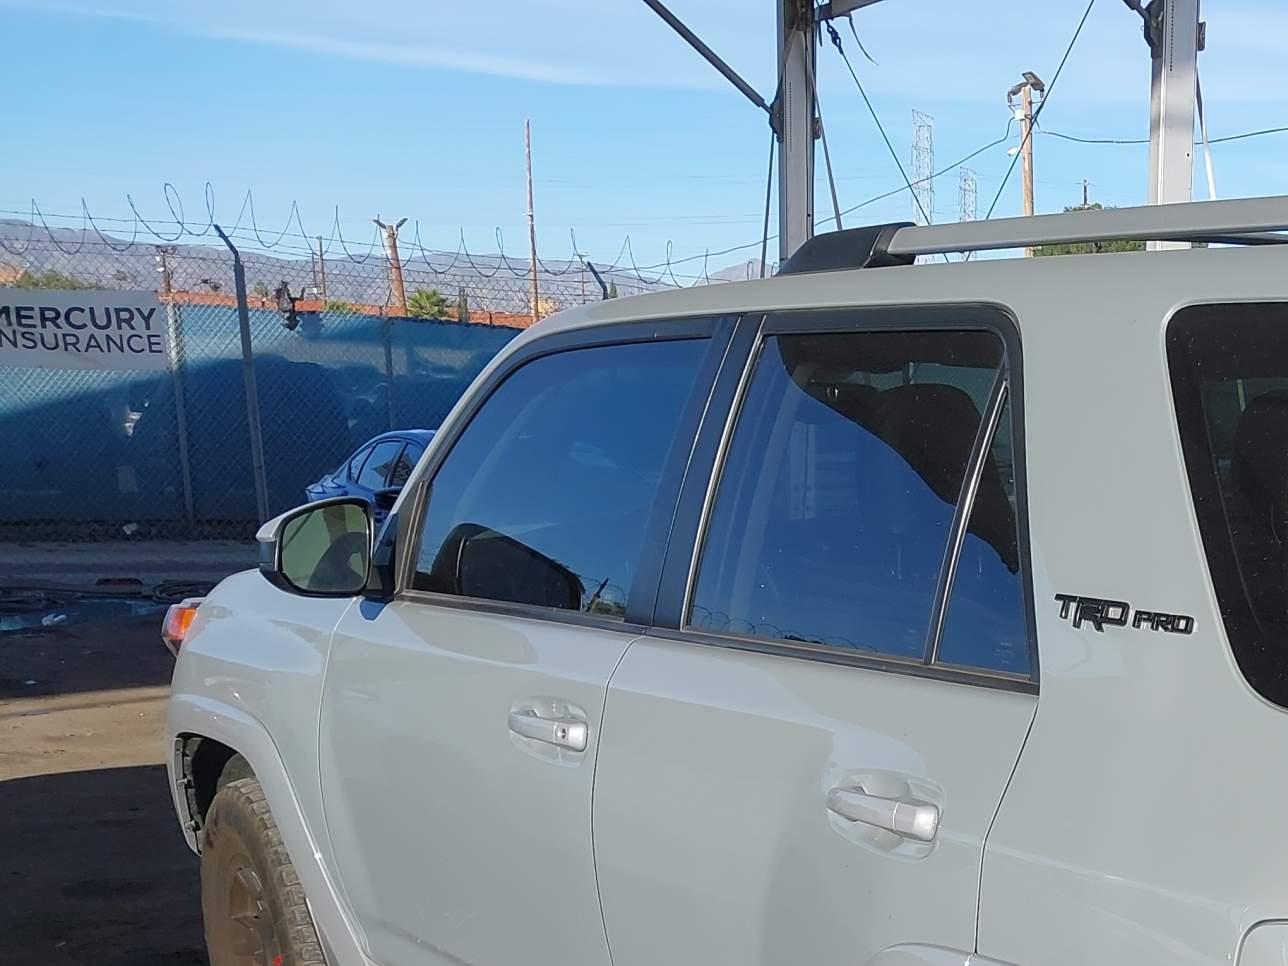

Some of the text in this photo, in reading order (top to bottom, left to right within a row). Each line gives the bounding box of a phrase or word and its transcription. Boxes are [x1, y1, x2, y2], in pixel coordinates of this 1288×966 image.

[0, 330, 163, 353] NSURANCE
[1054, 593, 1195, 635] TRD PRO
